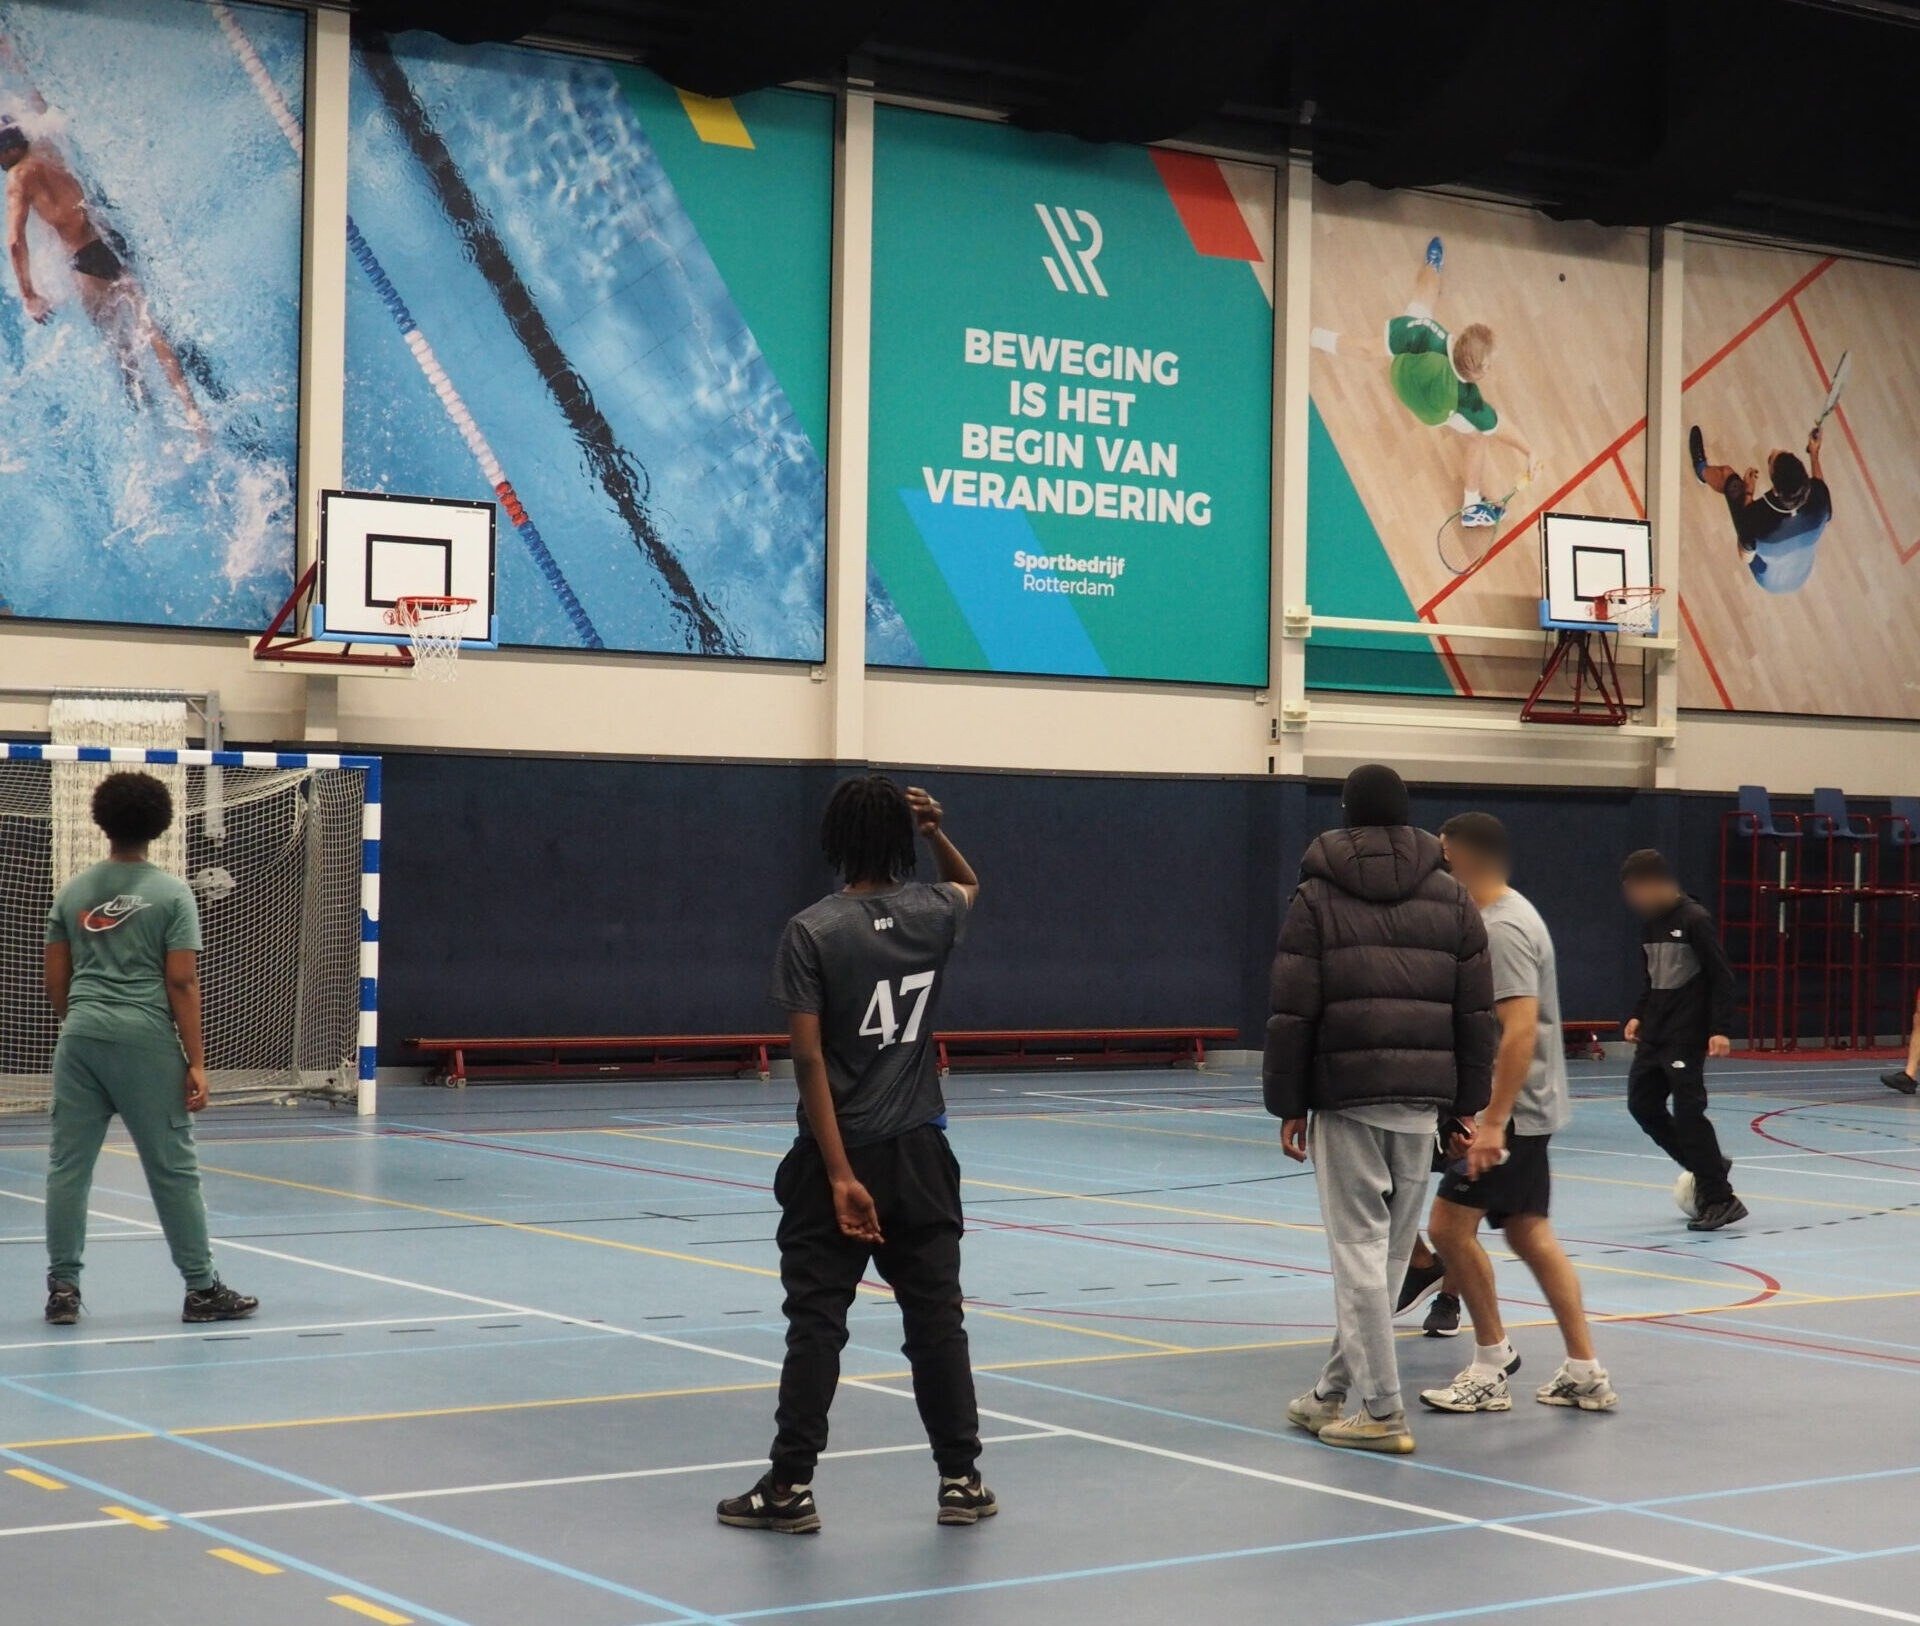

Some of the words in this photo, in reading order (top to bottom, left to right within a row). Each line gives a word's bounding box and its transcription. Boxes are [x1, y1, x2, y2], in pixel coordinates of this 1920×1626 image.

[965, 328, 1179, 386] BEWEGING
[1010, 380, 1047, 418] IS
[1058, 386, 1136, 427] HET
[962, 423, 1084, 469] BEGIN
[1095, 436, 1178, 478] VAN
[922, 466, 1211, 527] VERANDERING
[1013, 550, 1126, 578] Sportbedrijf
[1023, 574, 1115, 597] Rotterdam
[858, 970, 936, 1050] 47
